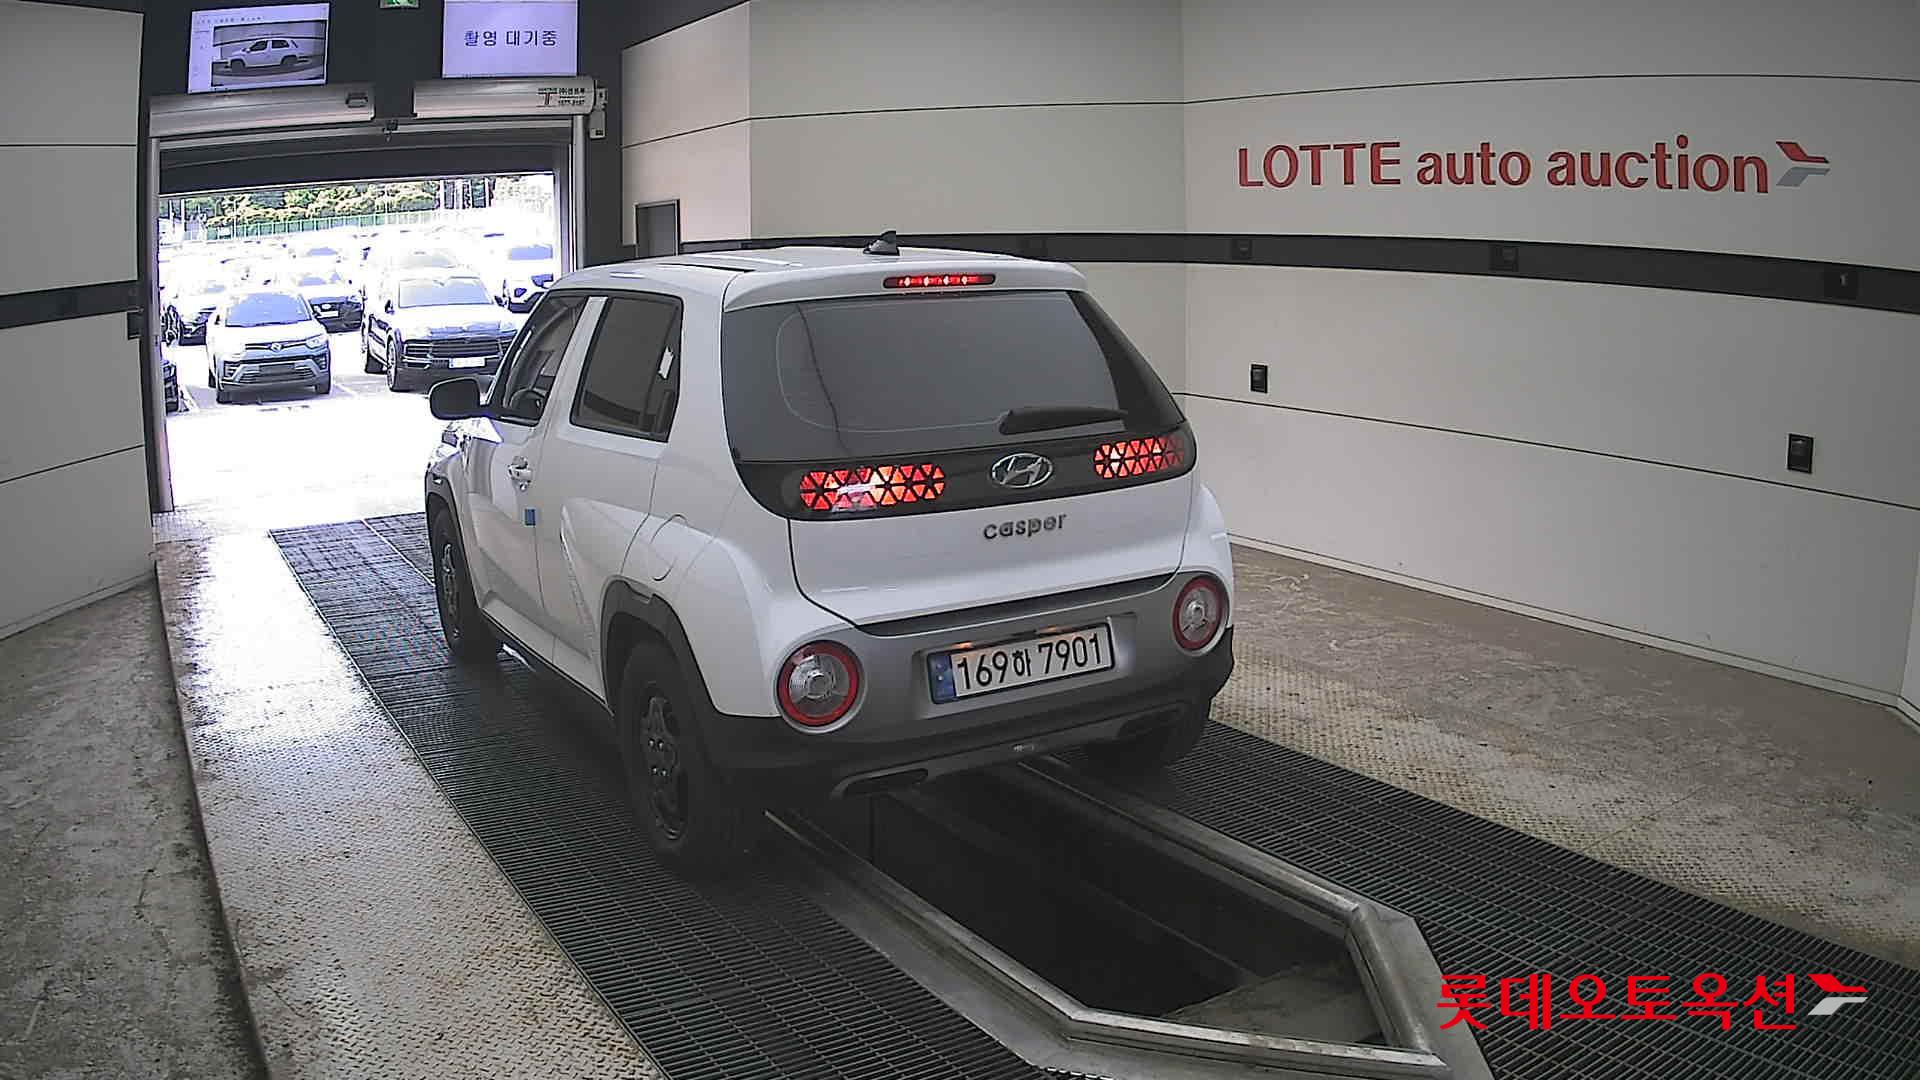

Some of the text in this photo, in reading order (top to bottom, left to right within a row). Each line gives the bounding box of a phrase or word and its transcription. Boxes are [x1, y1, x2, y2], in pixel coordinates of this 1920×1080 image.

[464, 30, 557, 46] 촬영 대기중
[1239, 136, 1768, 193] LOTTE auto auction
[983, 513, 1067, 540] casper
[957, 632, 1101, 690] 169하 7901
